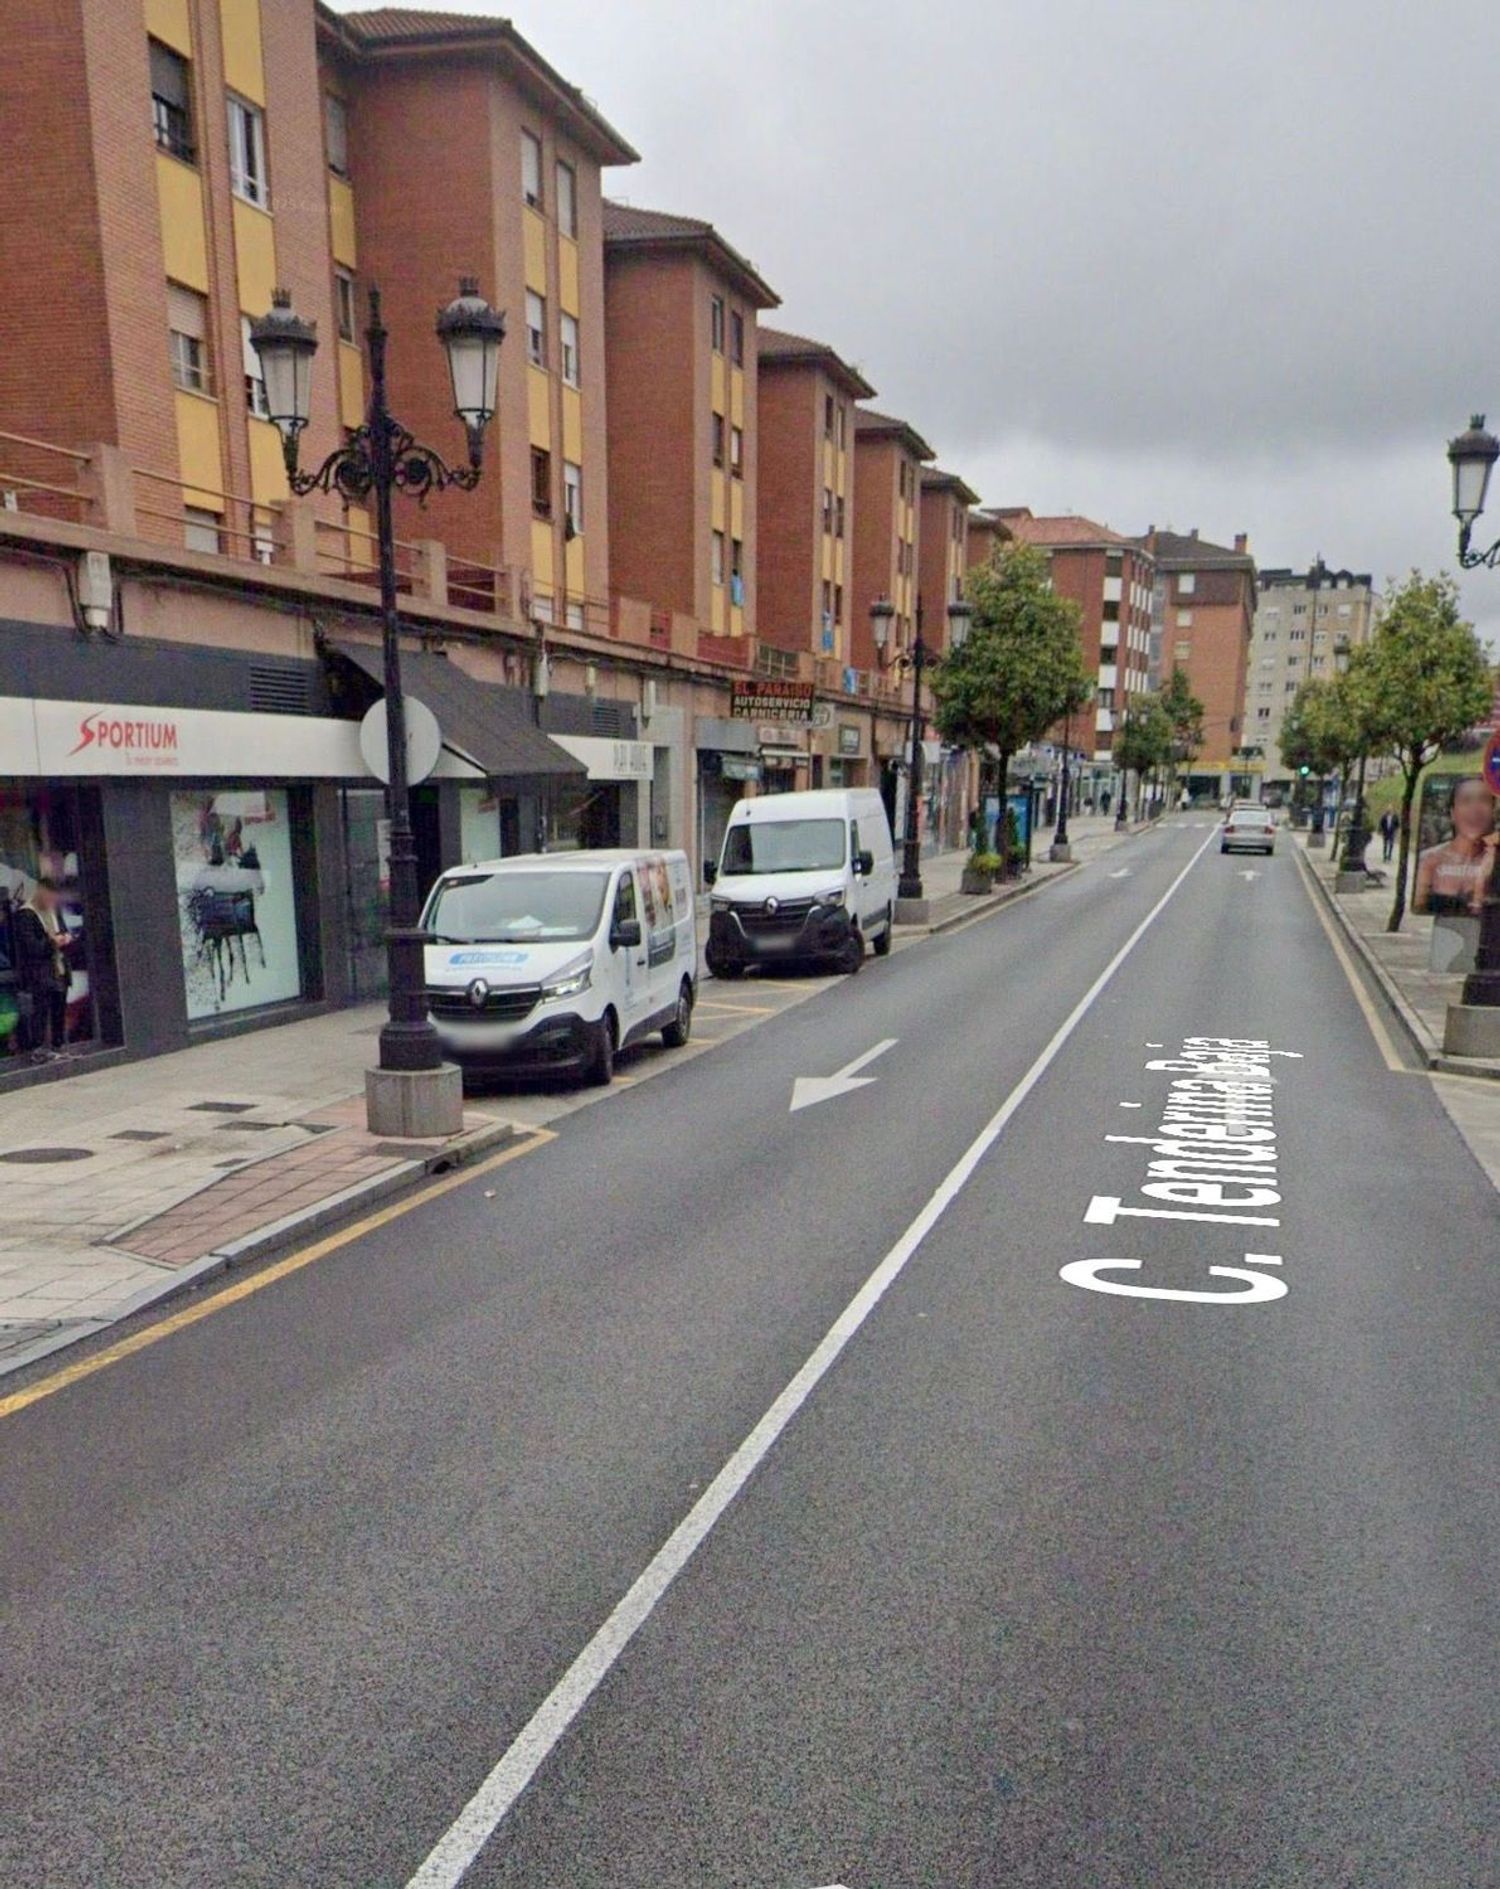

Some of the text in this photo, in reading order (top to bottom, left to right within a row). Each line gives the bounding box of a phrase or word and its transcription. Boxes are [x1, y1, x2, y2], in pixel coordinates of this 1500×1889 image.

[734, 680, 750, 695] EL
[734, 696, 811, 710] AUTOSERVICIO
[66, 710, 178, 757] SPORTIUM
